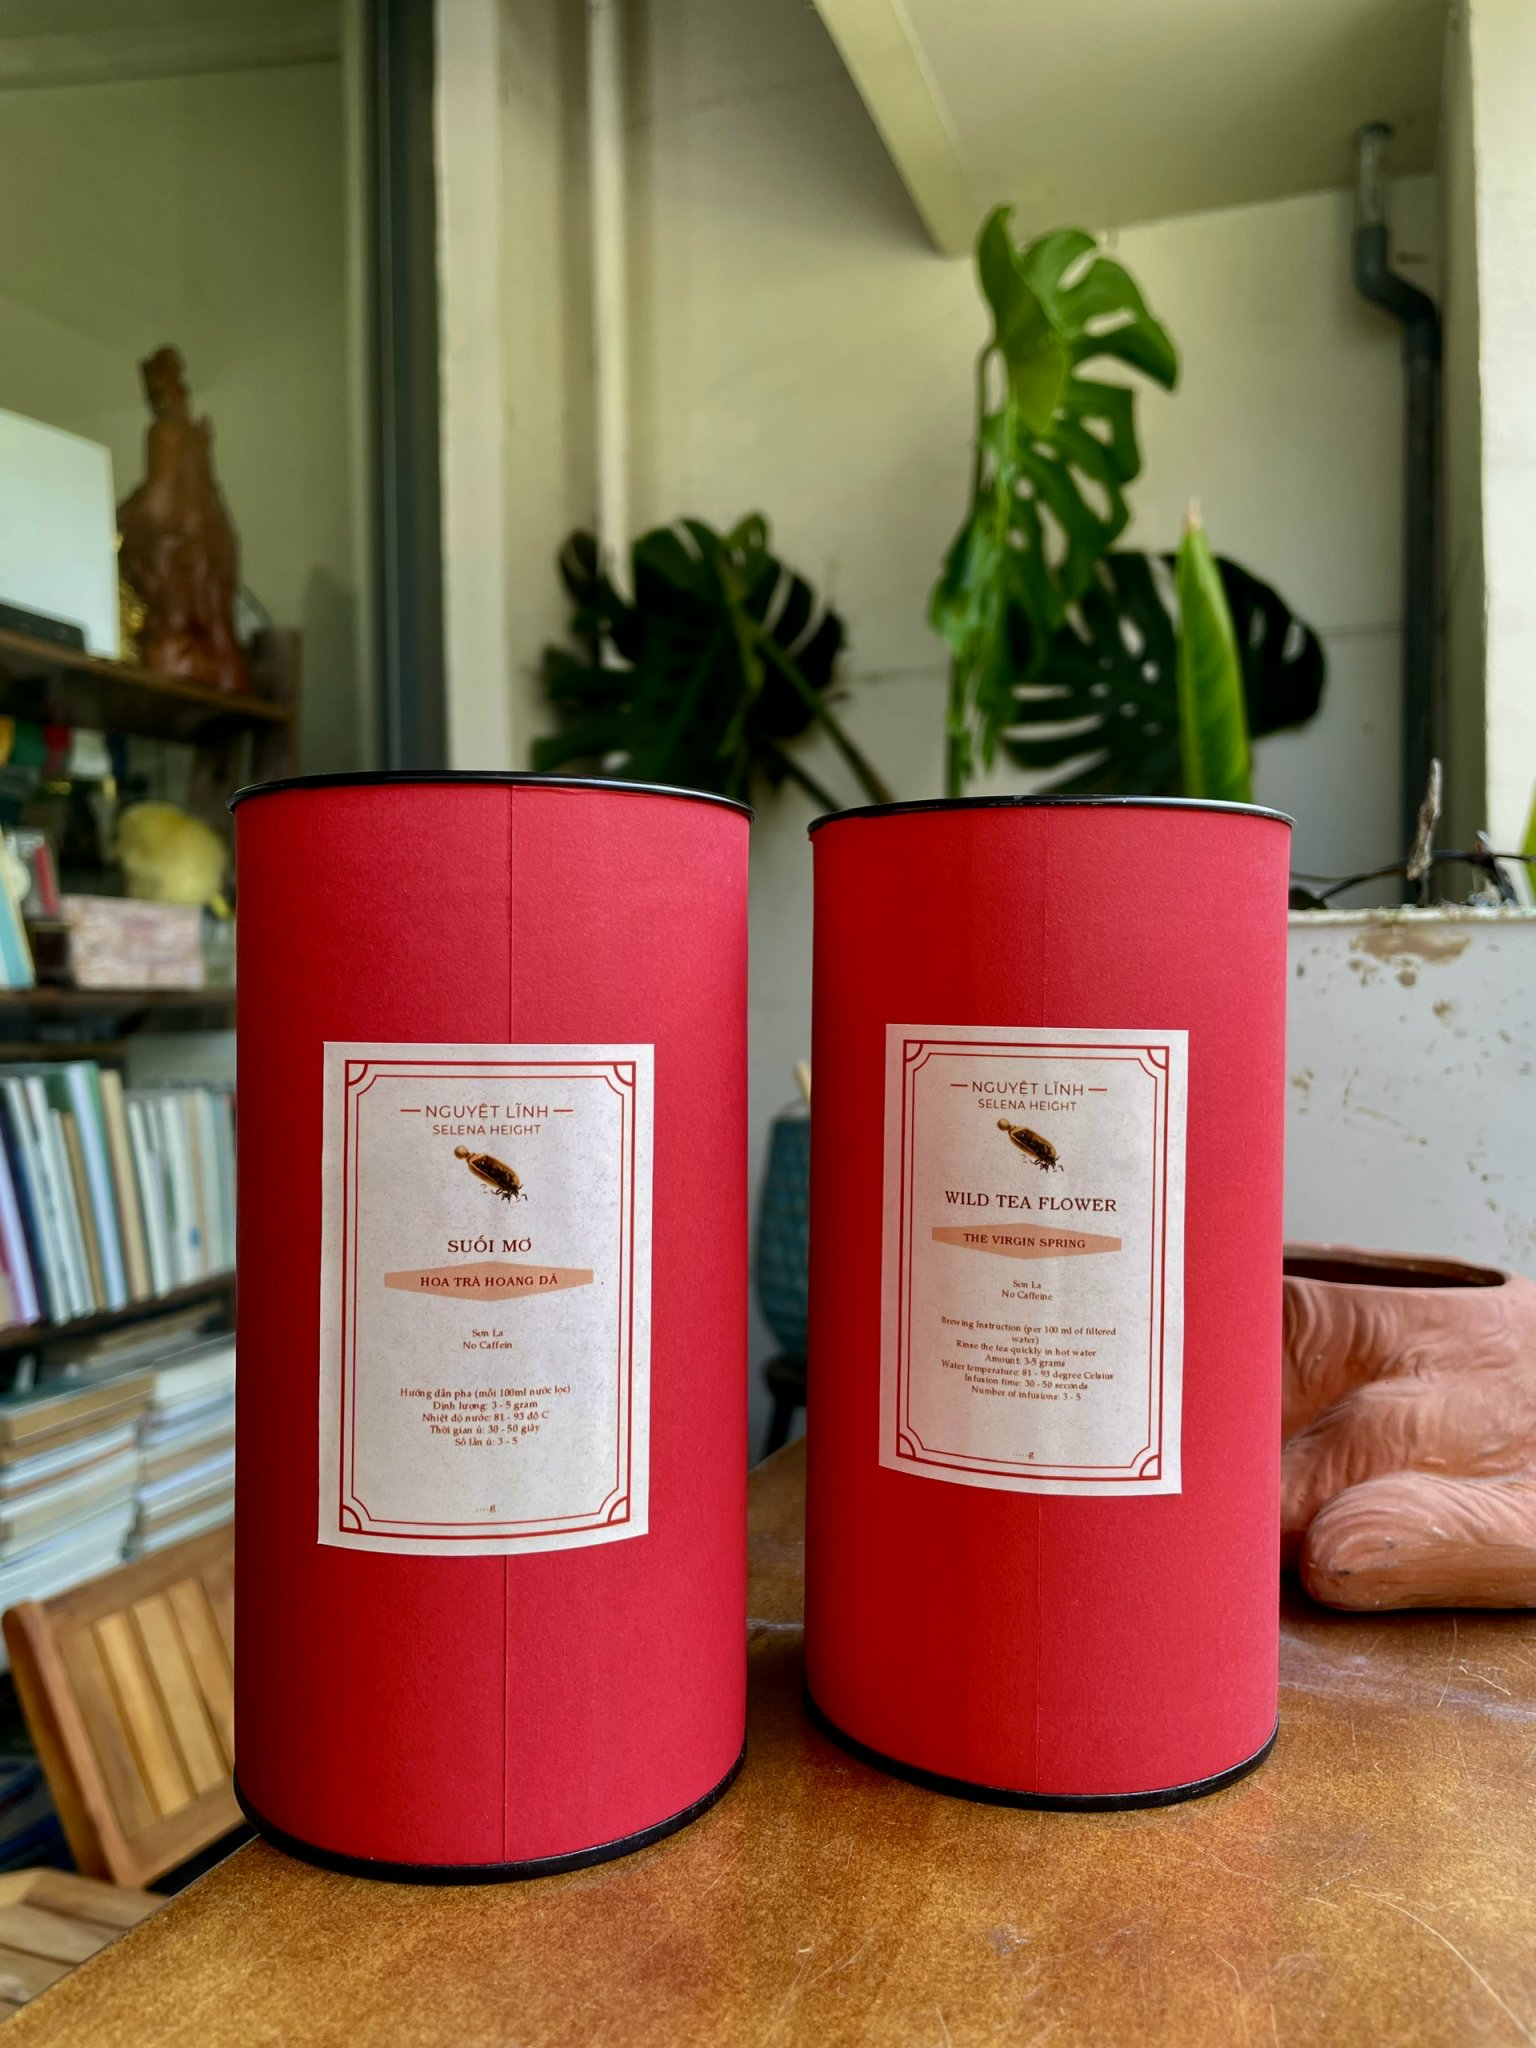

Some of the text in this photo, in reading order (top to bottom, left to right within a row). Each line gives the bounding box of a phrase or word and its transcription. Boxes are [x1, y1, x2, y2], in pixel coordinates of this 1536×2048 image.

[972, 1080, 1084, 1097] NGUYỆT LĨNH
[426, 1101, 549, 1120] NGUYỆT LĨNH
[978, 1098, 1077, 1112] SELENA HEIGHT
[432, 1124, 541, 1135] SELENA HEIGHT
[945, 1191, 1117, 1212] WILD TEA FLOWER
[448, 1235, 531, 1253] SUỐI MƠ
[963, 1233, 1086, 1248] THE VIRGIN SPRING
[421, 1277, 449, 1287] HOA
[453, 1275, 481, 1287] TRÀ
[485, 1276, 534, 1287] HOANG
[1032, 1281, 1041, 1289] La
[1001, 1290, 1053, 1301] No Caffeine
[941, 1316, 1116, 1336] Brewing Instruction (per 100 ml of filtered
[492, 1329, 503, 1337] La
[463, 1340, 512, 1350] No Caffein
[1011, 1336, 1039, 1345] water)
[956, 1339, 1096, 1357] Rinse the tea quickly in hot water
[941, 1359, 965, 1371] Water
[1022, 1369, 1032, 1377] 81
[1040, 1369, 1050, 1378] 93
[1052, 1370, 1081, 1381] degree
[1083, 1371, 1113, 1380] Celsius
[1039, 1360, 1065, 1369] grams
[964, 1373, 999, 1385] Infusion
[1025, 1379, 1035, 1388] 30
[1042, 1380, 1052, 1389] 50
[1055, 1381, 1088, 1390] seconds
[454, 1388, 471, 1400] pha
[500, 1387, 526, 1397] 100ml
[971, 1385, 1006, 1397] Number
[1007, 1389, 1016, 1398] of
[1062, 1392, 1068, 1400] 3
[491, 1401, 497, 1409] 3
[505, 1400, 512, 1409] 5
[514, 1401, 538, 1411] gram
[494, 1413, 504, 1422] 81
[513, 1413, 524, 1421] 93
[453, 1425, 472, 1436] gian
[488, 1425, 499, 1434] 30
[507, 1424, 518, 1433] 50
[498, 1437, 504, 1445] 3
[511, 1437, 518, 1445] 5
